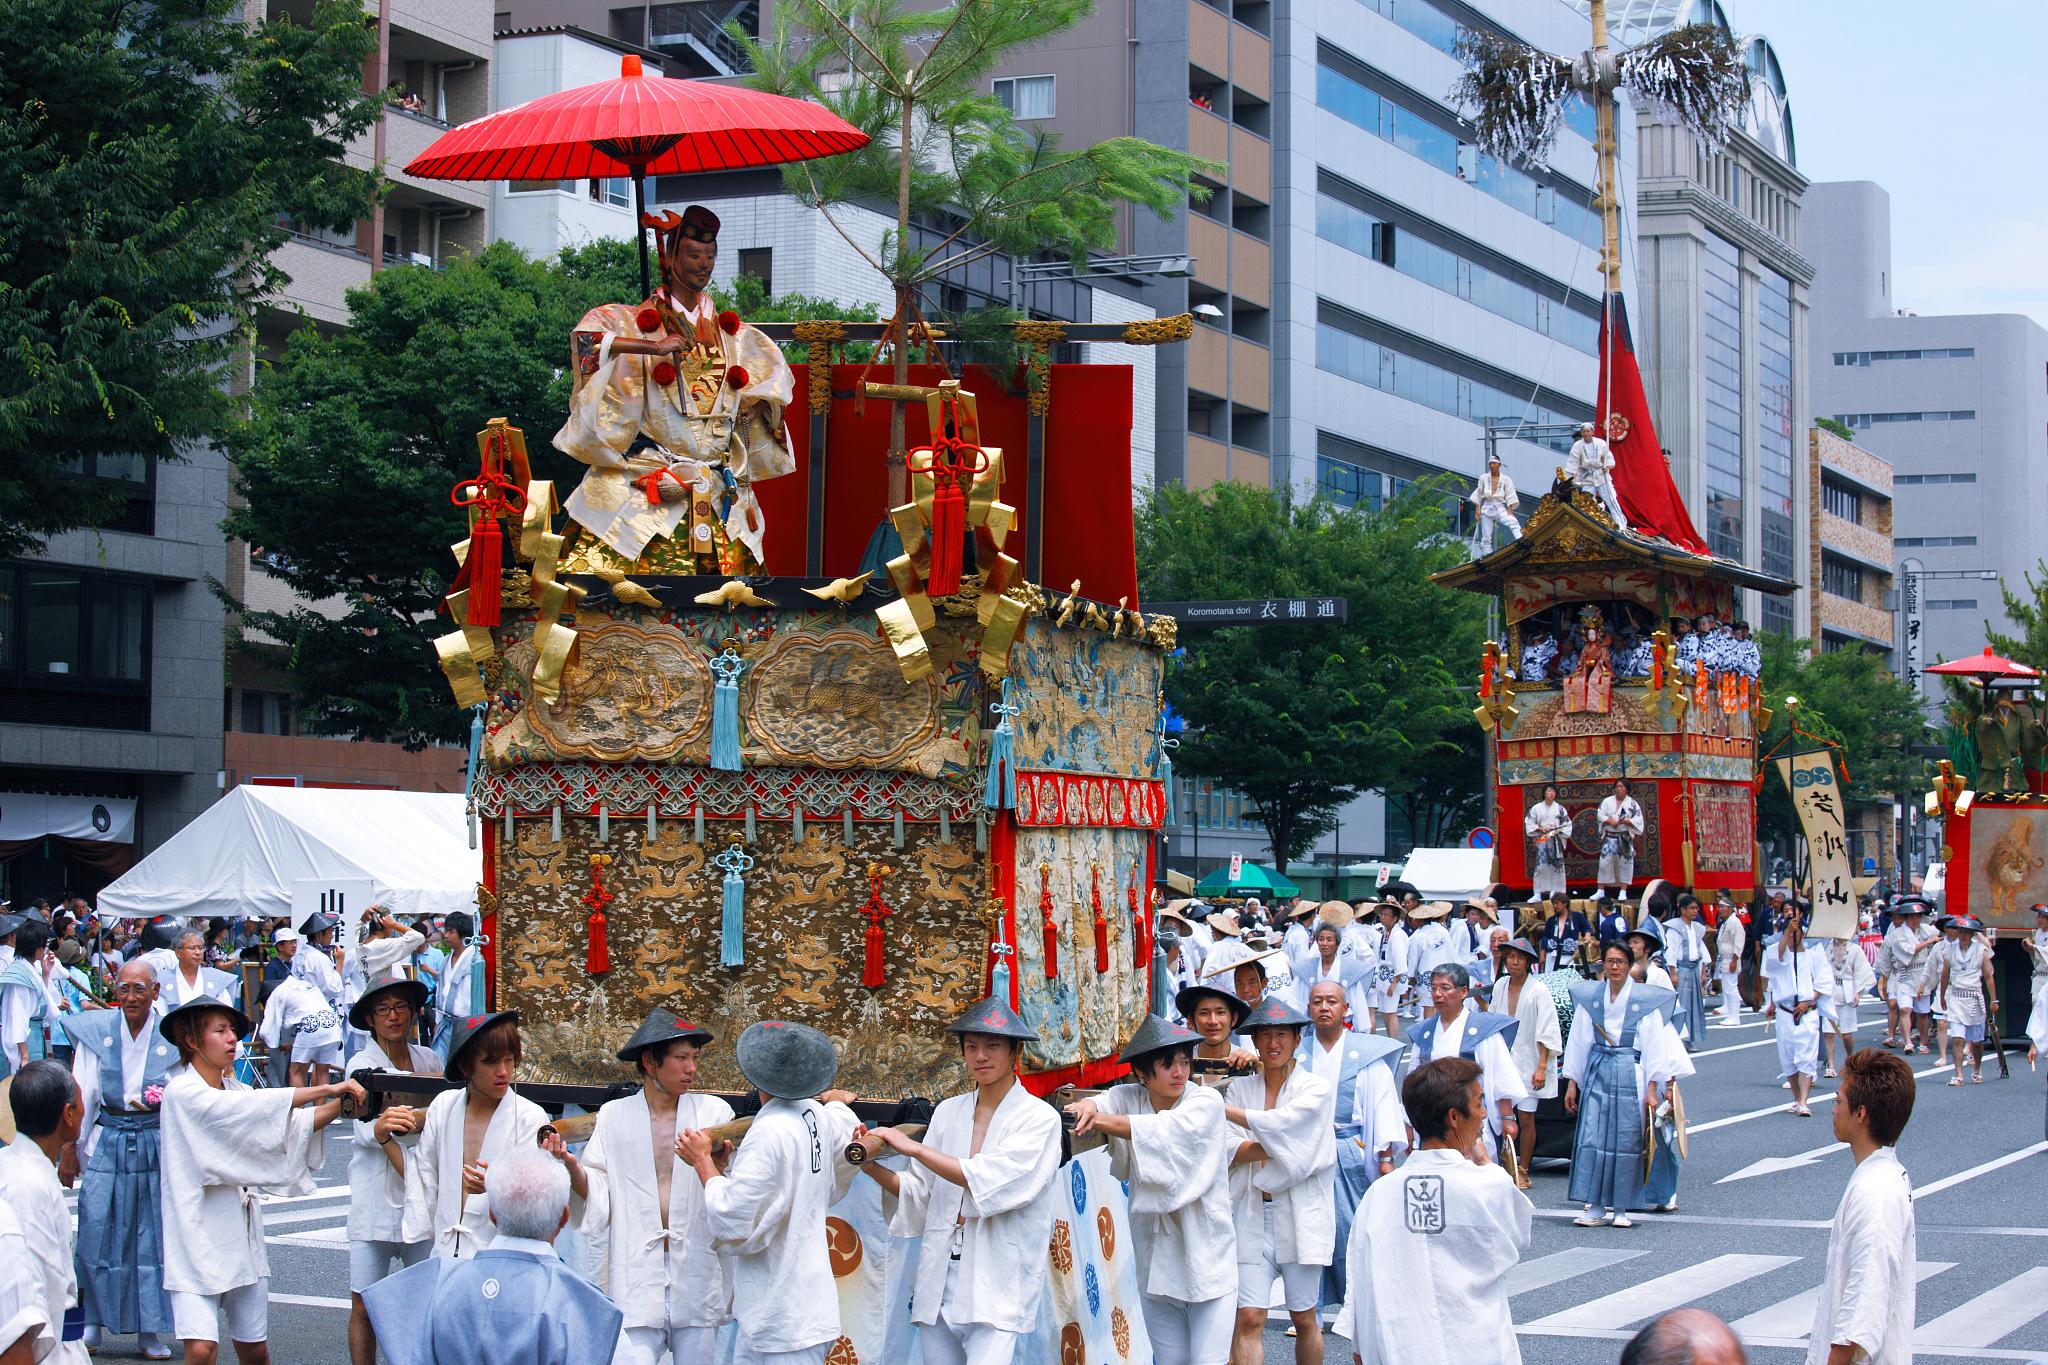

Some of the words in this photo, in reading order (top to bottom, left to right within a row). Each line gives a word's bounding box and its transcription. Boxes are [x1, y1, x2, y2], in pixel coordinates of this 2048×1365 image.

[1188, 607, 1234, 616] Koromotana
[1235, 606, 1250, 615] dori
[1259, 600, 1335, 618] 衣棚通
